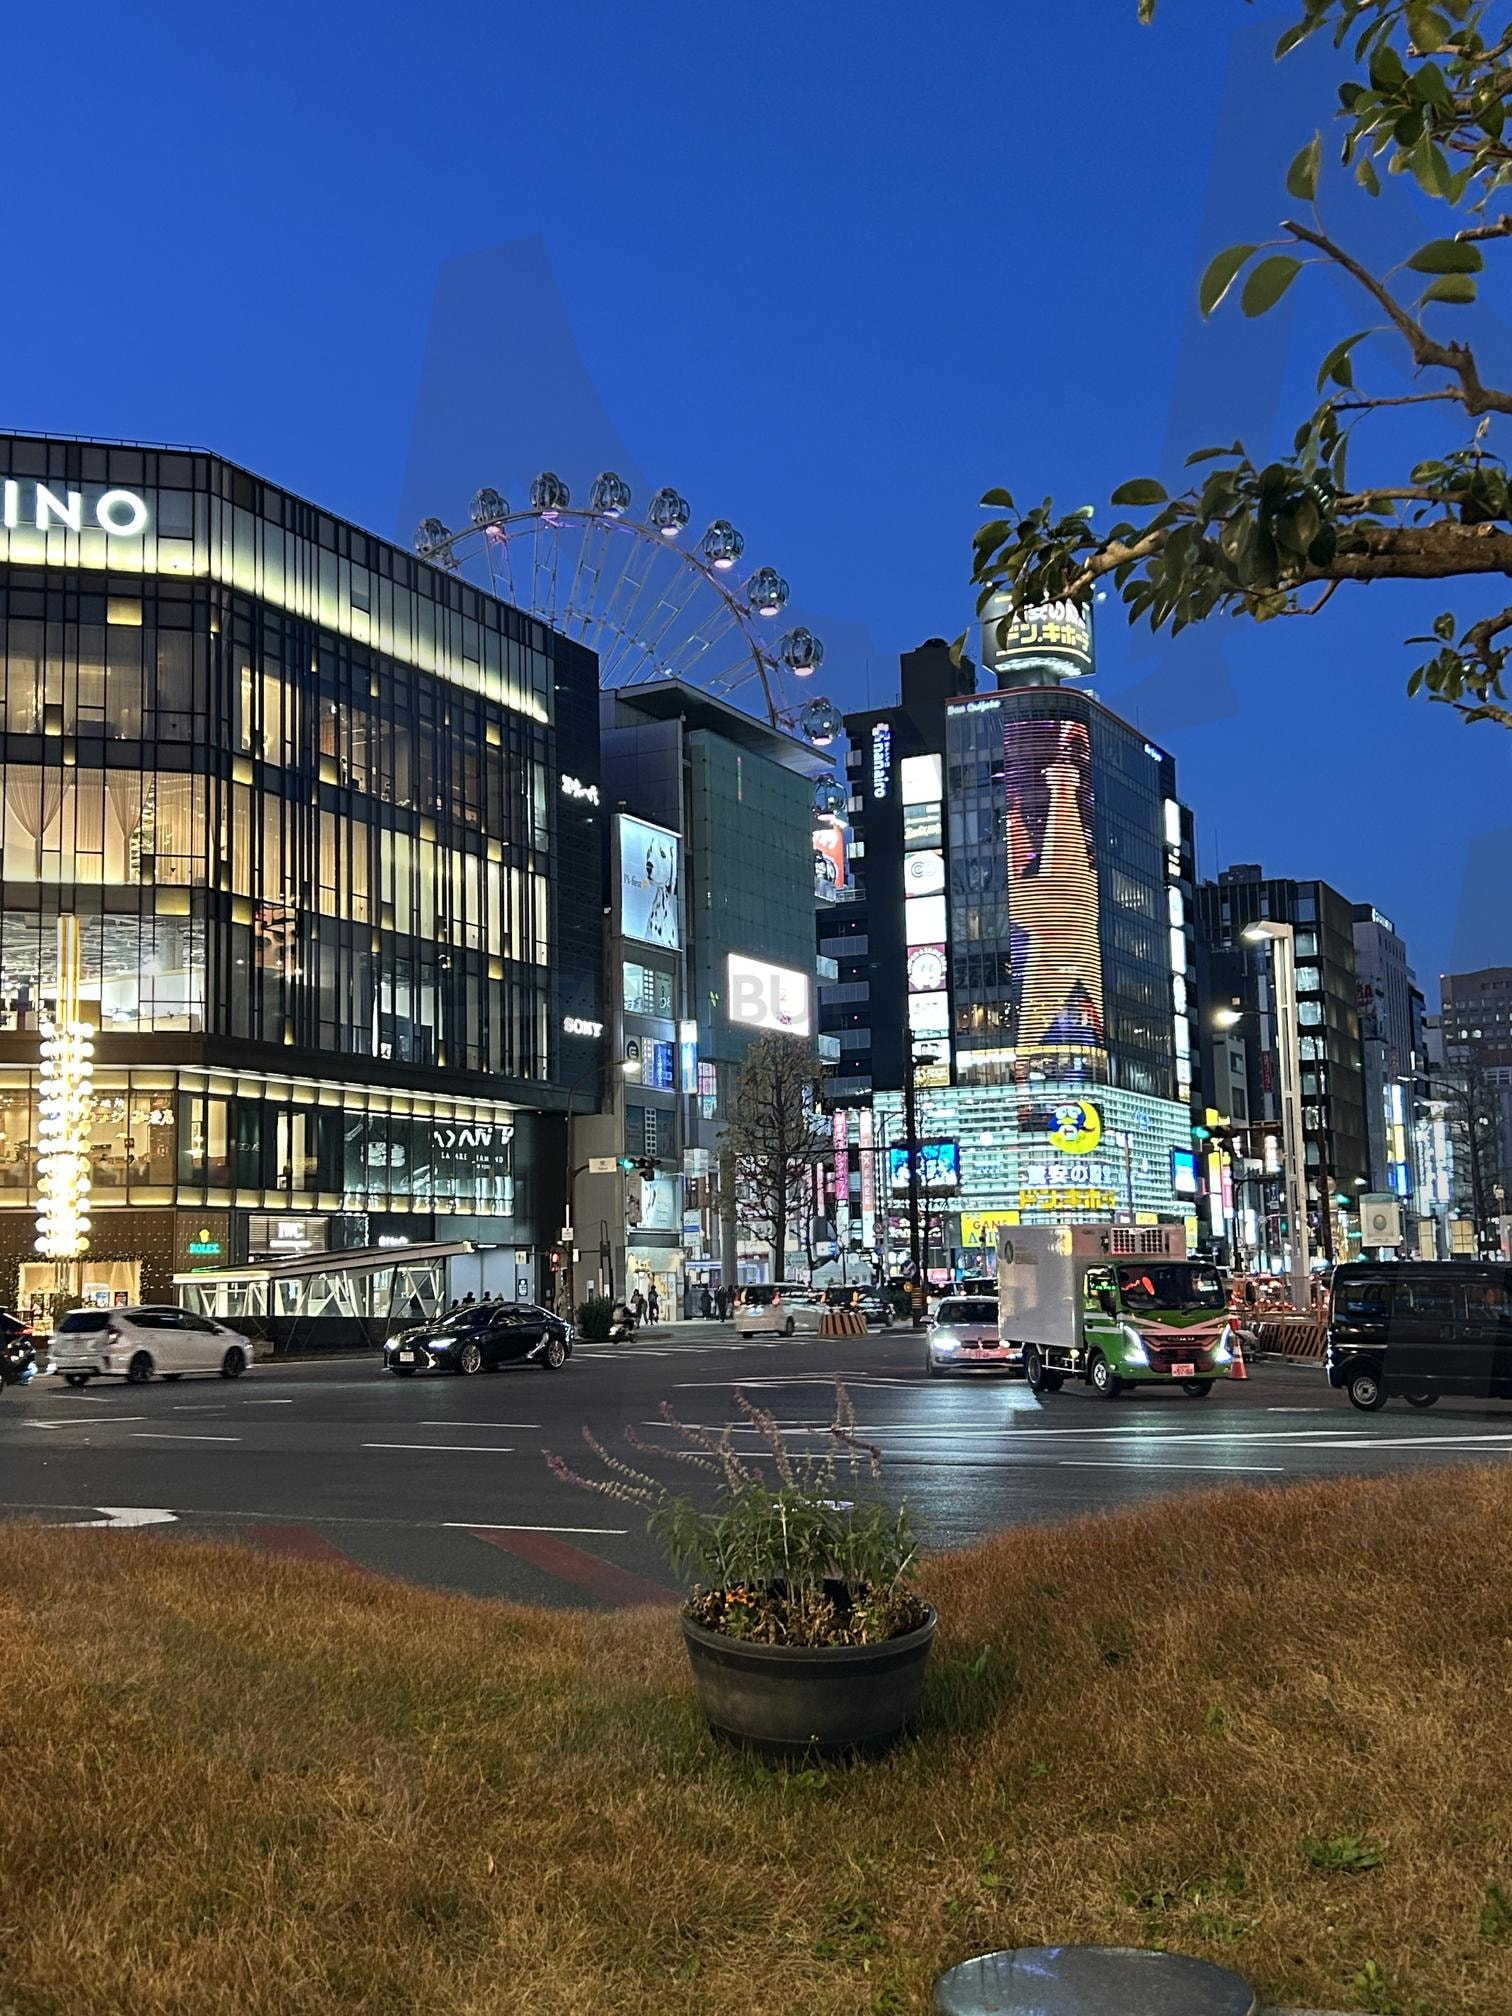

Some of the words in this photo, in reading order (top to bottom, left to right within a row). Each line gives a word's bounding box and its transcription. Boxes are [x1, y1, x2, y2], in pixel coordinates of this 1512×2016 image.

[4, 480, 148, 536] INO
[564, 1016, 604, 1037] SONY
[863, 1169, 874, 1205] FREE
